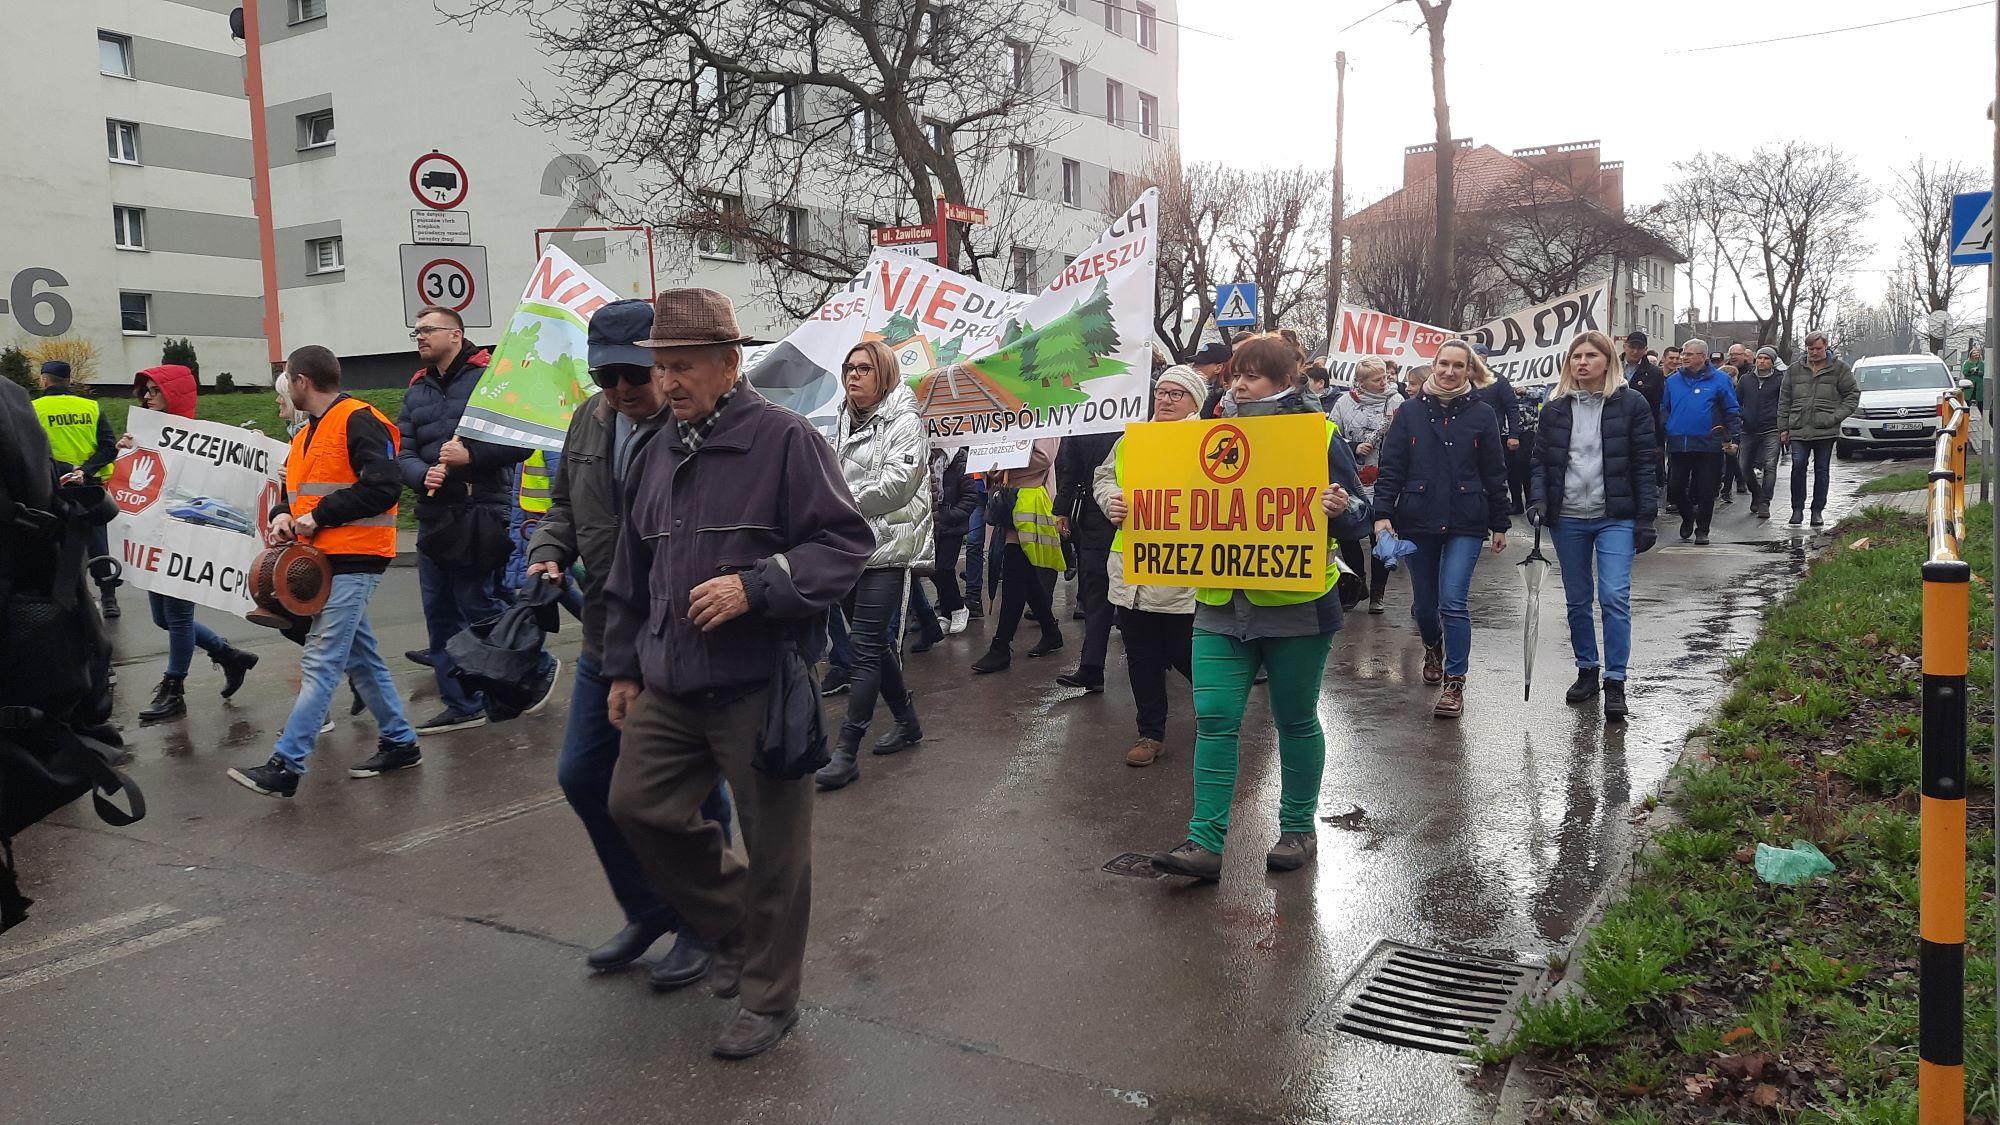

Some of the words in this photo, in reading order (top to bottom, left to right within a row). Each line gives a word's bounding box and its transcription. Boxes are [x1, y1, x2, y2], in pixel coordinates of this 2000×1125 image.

[434, 191, 446, 201] 7t
[882, 231, 894, 241] ul.
[427, 273, 465, 298] 30
[881, 260, 967, 330] NIE
[1339, 310, 1410, 357] NIE!
[1533, 289, 1603, 348] CPK
[48, 413, 93, 427] POLICJA
[928, 415, 965, 438] ASZ
[970, 403, 1079, 434] WSPÓLNY
[1083, 396, 1142, 423] DOM
[115, 489, 147, 506] STOP
[1133, 489, 1182, 531] NIE
[1189, 488, 1248, 531] DLA
[1256, 486, 1317, 532] CPK
[123, 539, 162, 572] NIE
[166, 552, 214, 587] DLA
[1133, 542, 1204, 576] PRZEZ
[1211, 543, 1314, 579] ORZESZE
